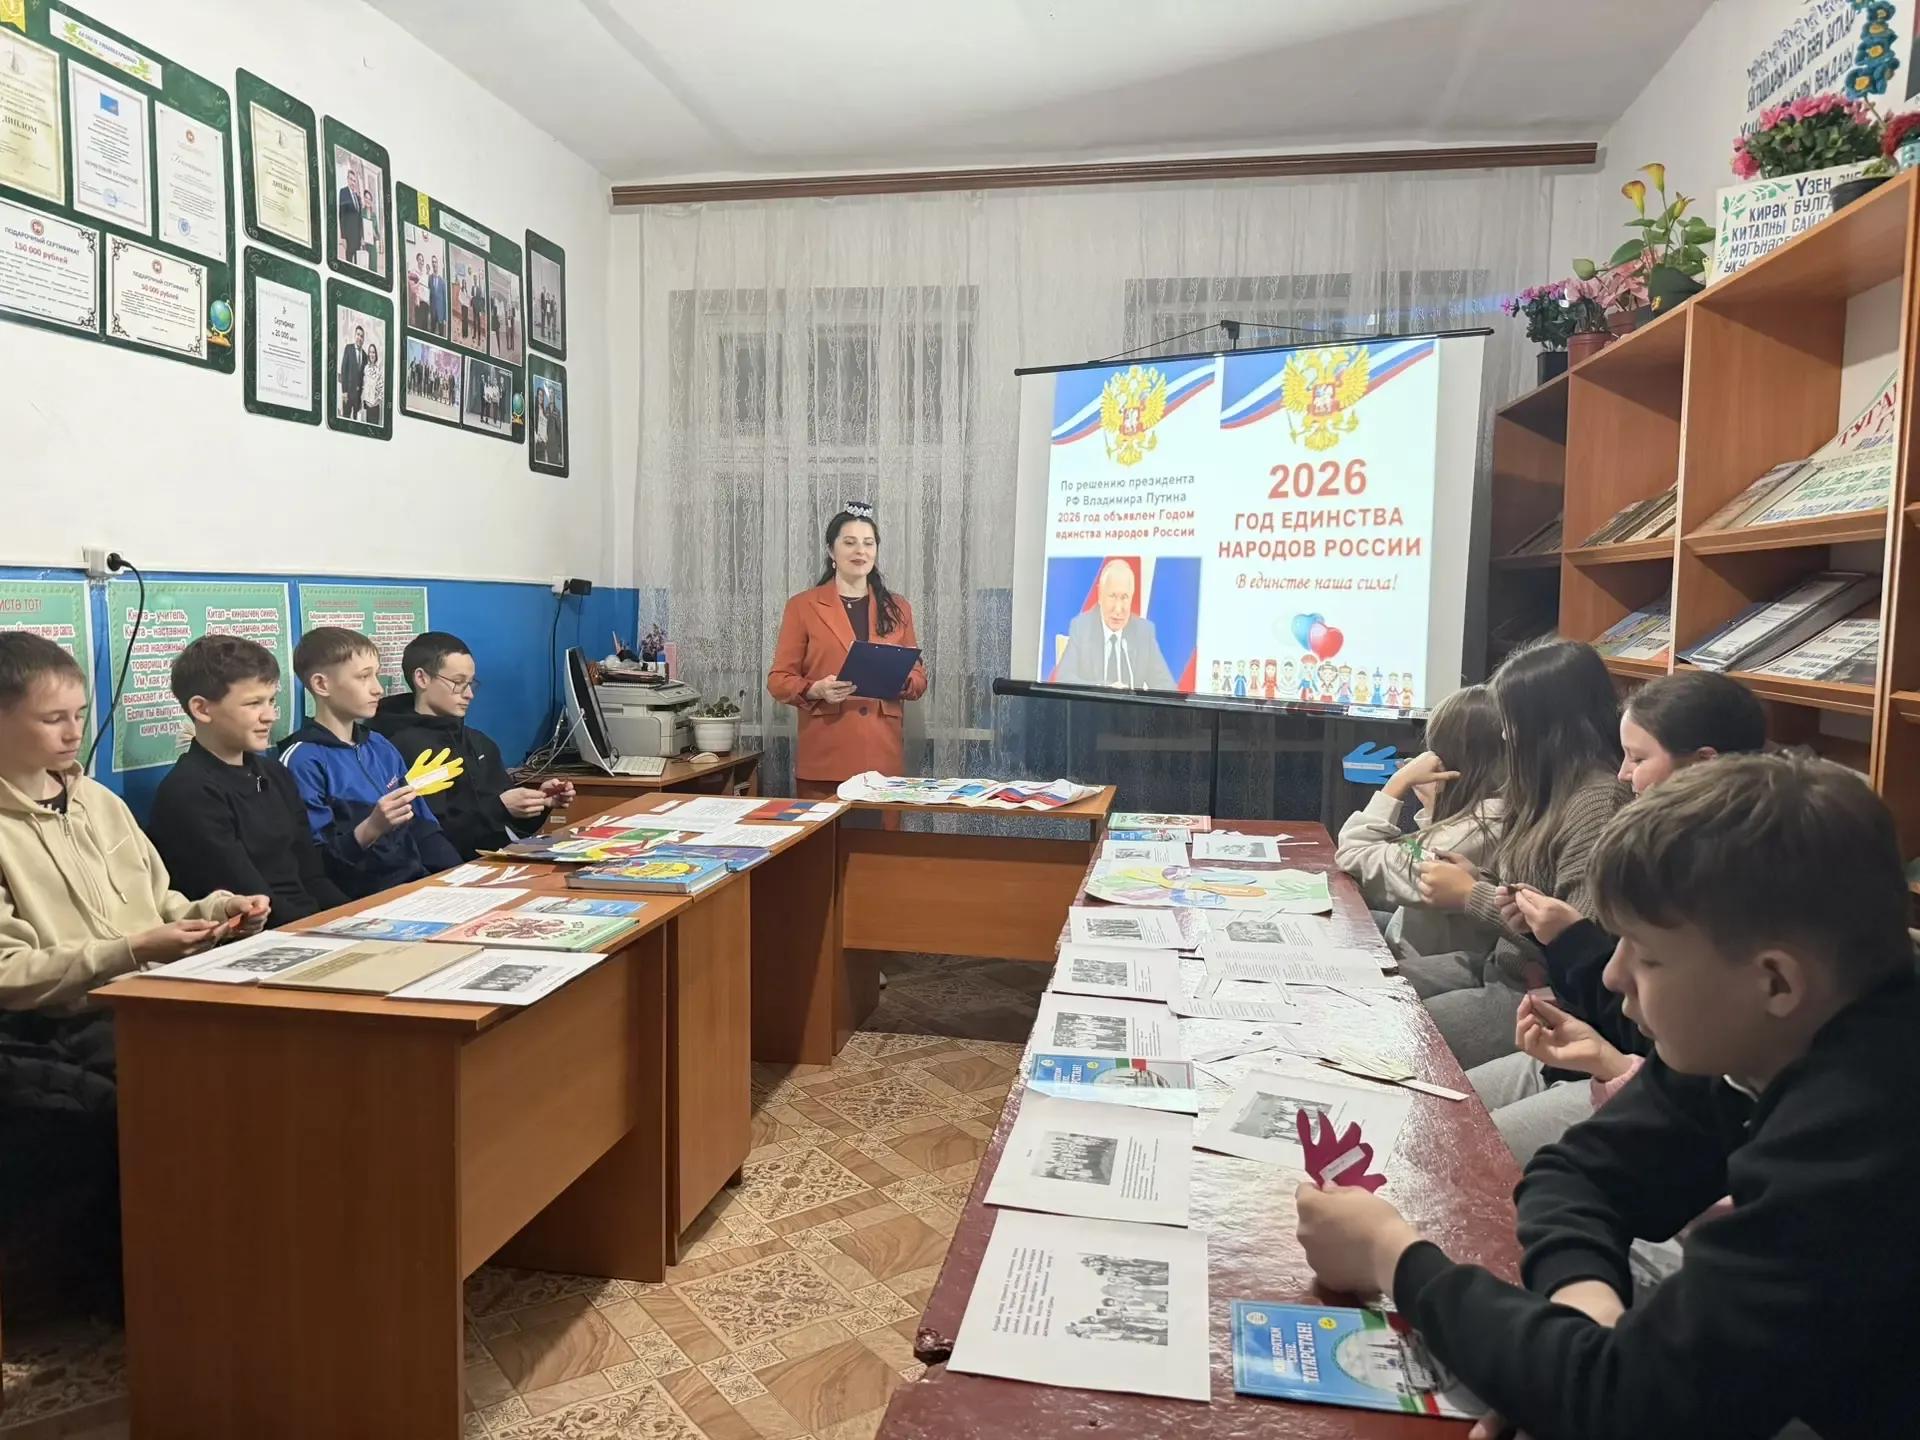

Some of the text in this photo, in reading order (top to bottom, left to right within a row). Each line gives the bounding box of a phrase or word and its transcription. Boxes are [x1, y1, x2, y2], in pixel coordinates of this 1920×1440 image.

[1749, 202, 1787, 223] КИРӘК
[1732, 220, 1786, 242] КИТАПНЫ
[14, 241, 68, 264] 150 000 рублей
[1061, 474, 1195, 492] По решению президента
[1267, 458, 1367, 499] 2026
[1065, 491, 1187, 507] РФ Владимира Путина
[1058, 508, 1195, 523] 2026 год объявлен Годом
[1234, 506, 1404, 533] ГОД ЕДИНСТВА
[1055, 526, 1195, 540] единства народов России
[1218, 537, 1421, 561] НАРОДОВ РОССИИ
[1235, 572, 1247, 589] В
[1314, 577, 1353, 590] наша
[1357, 573, 1398, 591] сила!
[156, 610, 187, 622] учитель,
[207, 608, 225, 619] Китап
[152, 627, 191, 637] наставник,
[132, 660, 162, 671] товарищ
[149, 676, 160, 685] как
[127, 709, 145, 720] Если
[146, 709, 155, 717] ты
[141, 725, 159, 736] книгу
[160, 723, 168, 732] из
[1296, 1321, 1320, 1383] ТАТАРСТАН!
